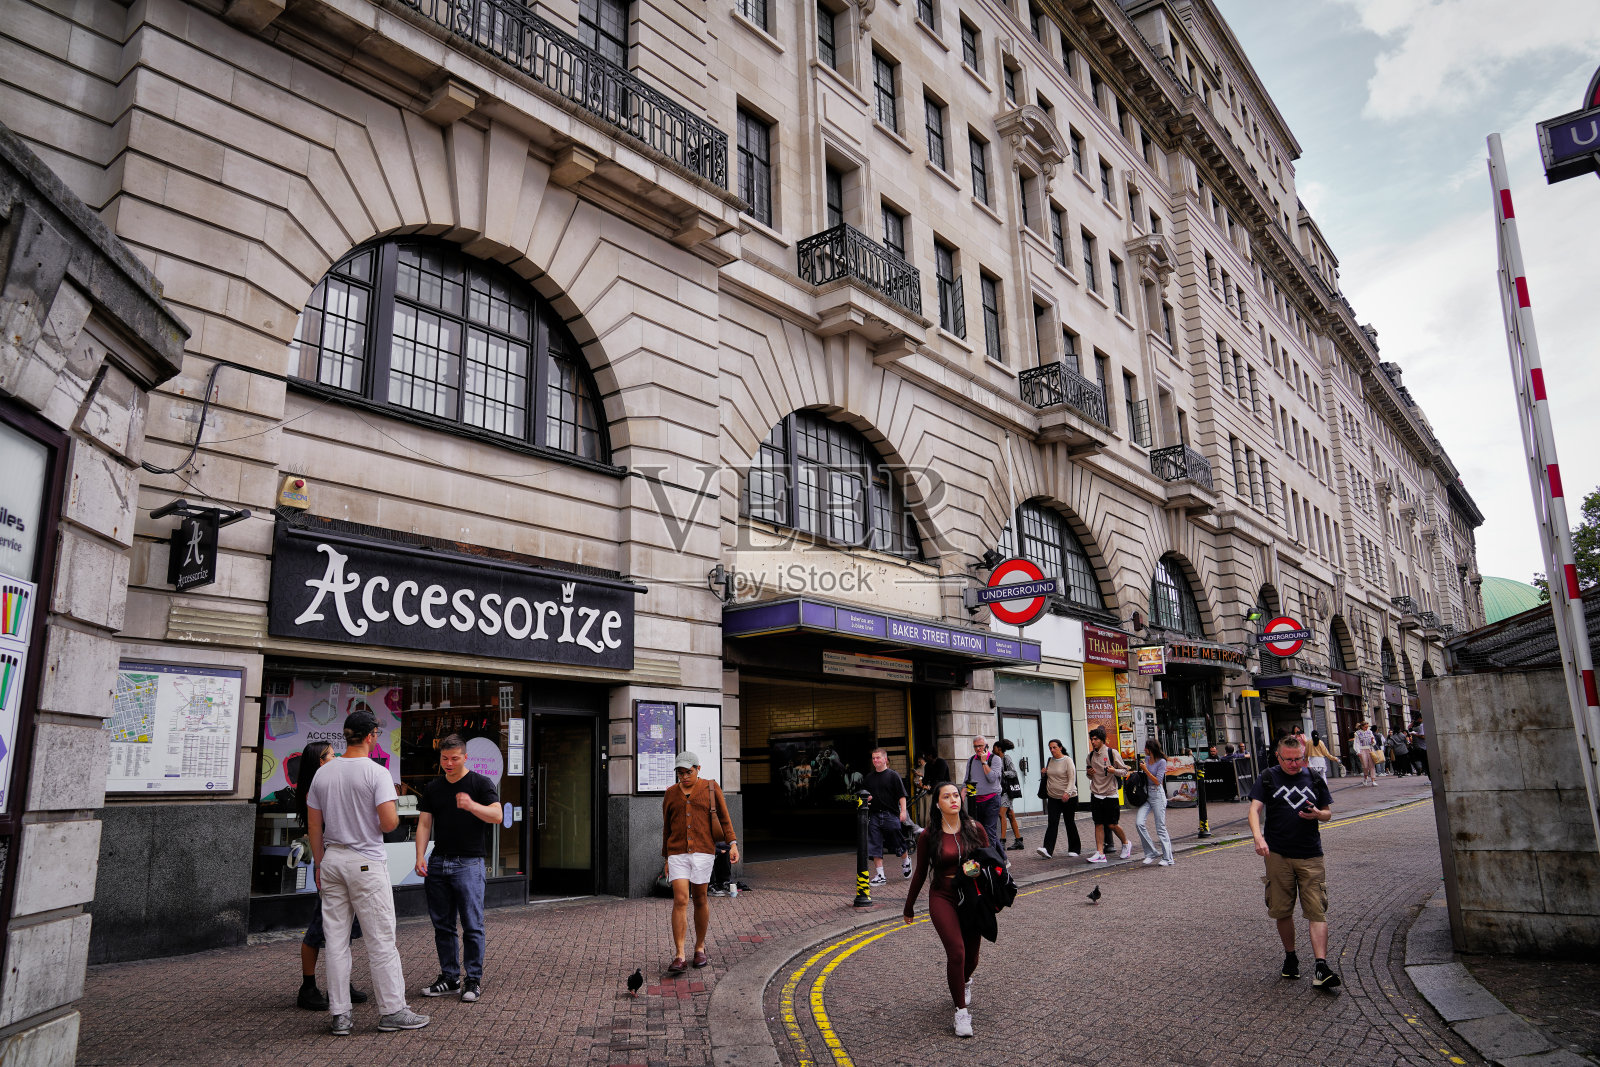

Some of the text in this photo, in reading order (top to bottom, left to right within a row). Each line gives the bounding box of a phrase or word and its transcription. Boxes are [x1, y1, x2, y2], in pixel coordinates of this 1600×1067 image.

[294, 544, 622, 654] Accessorize
[982, 582, 1054, 600] UNDERGROUND
[892, 623, 982, 650] BAKER STREET STATION
[1258, 631, 1309, 642] UNDERGROUND
[1088, 637, 1125, 658] THAI SPA
[1172, 644, 1199, 658] THE
